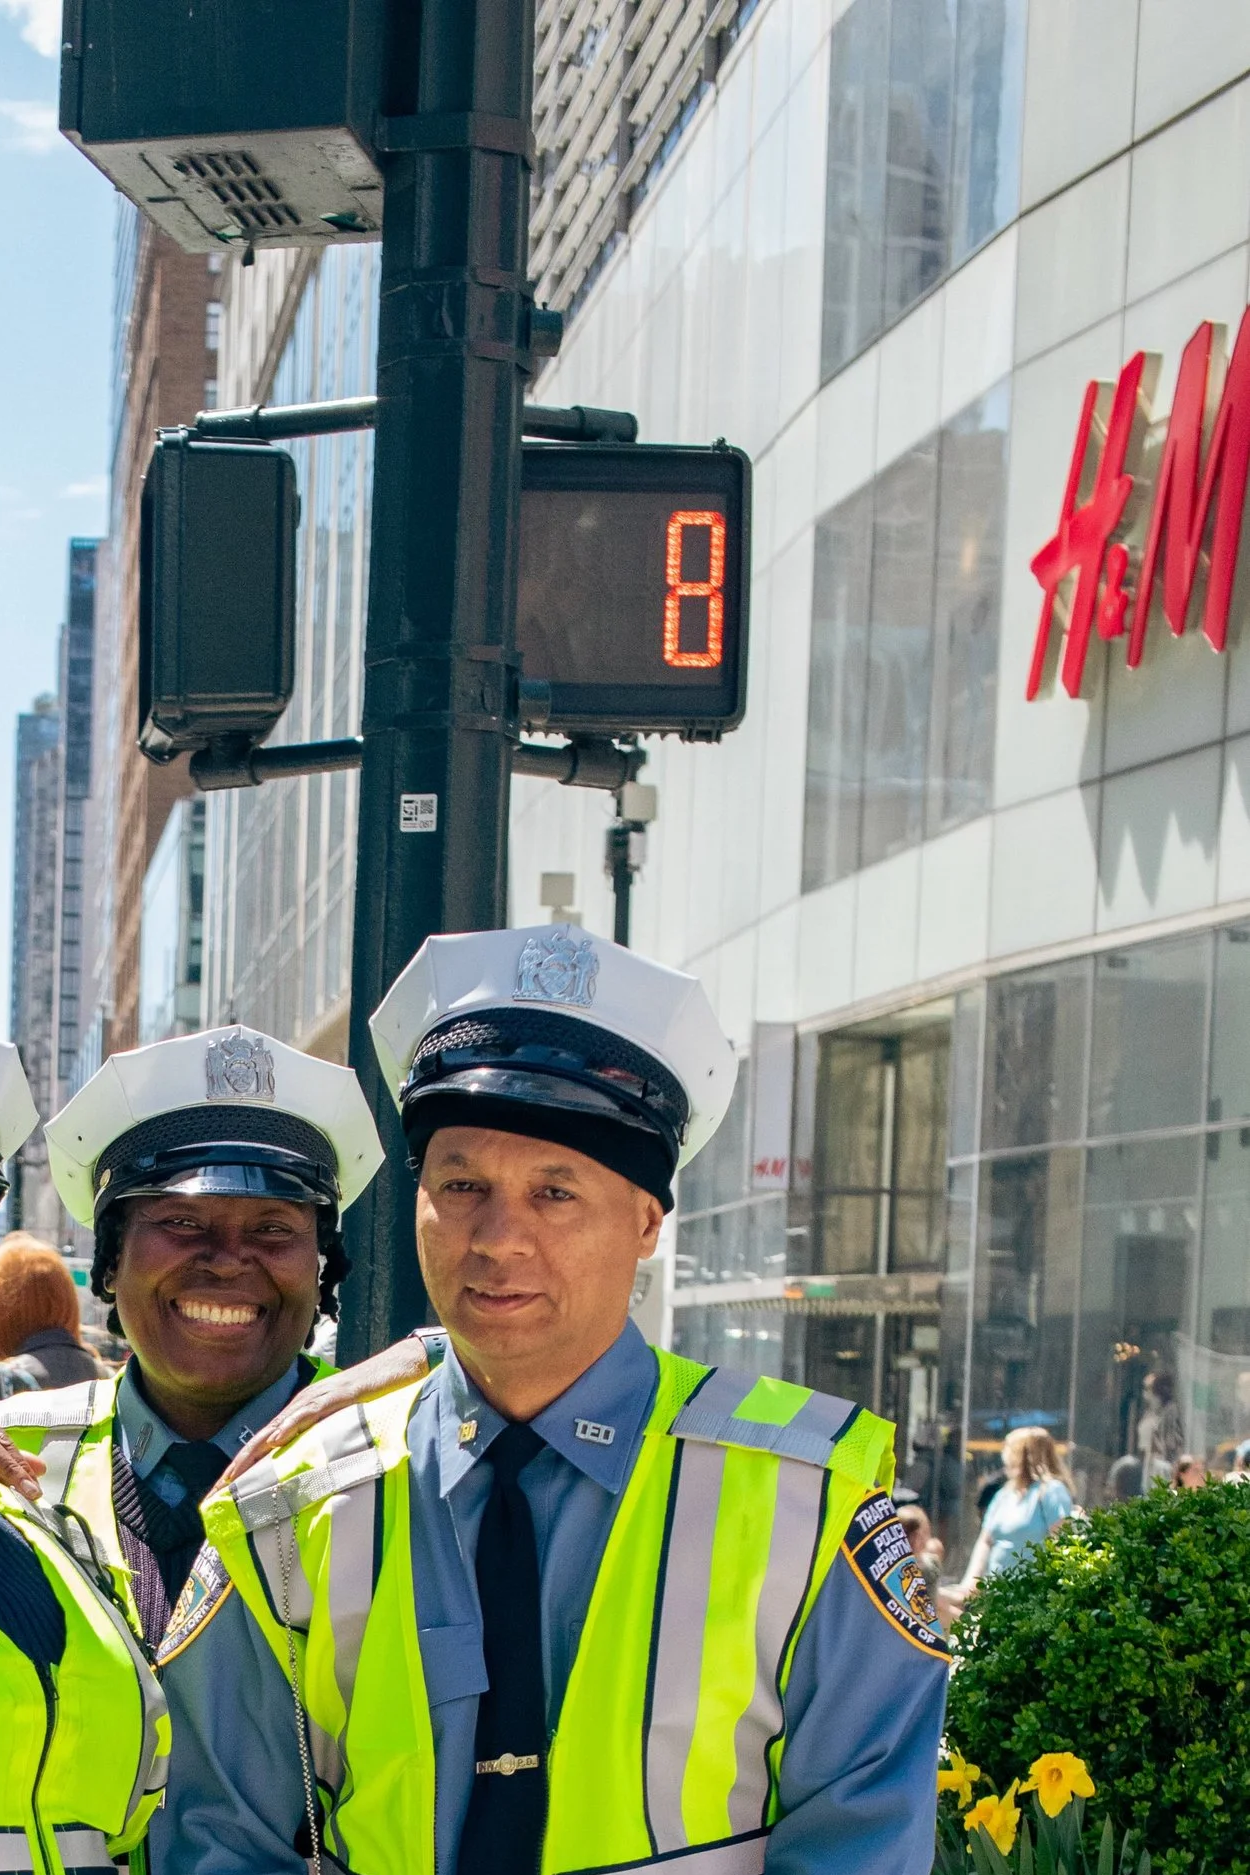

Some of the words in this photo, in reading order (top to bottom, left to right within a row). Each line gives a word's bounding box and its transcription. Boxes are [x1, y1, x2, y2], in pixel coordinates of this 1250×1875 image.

[1026, 303, 1250, 701] H&M
[664, 510, 726, 668] 8
[855, 1497, 897, 1532] TRAFFI
[873, 1523, 907, 1553] POLIC
[886, 1599, 918, 1630] CITY
[918, 1628, 936, 1644] OF
